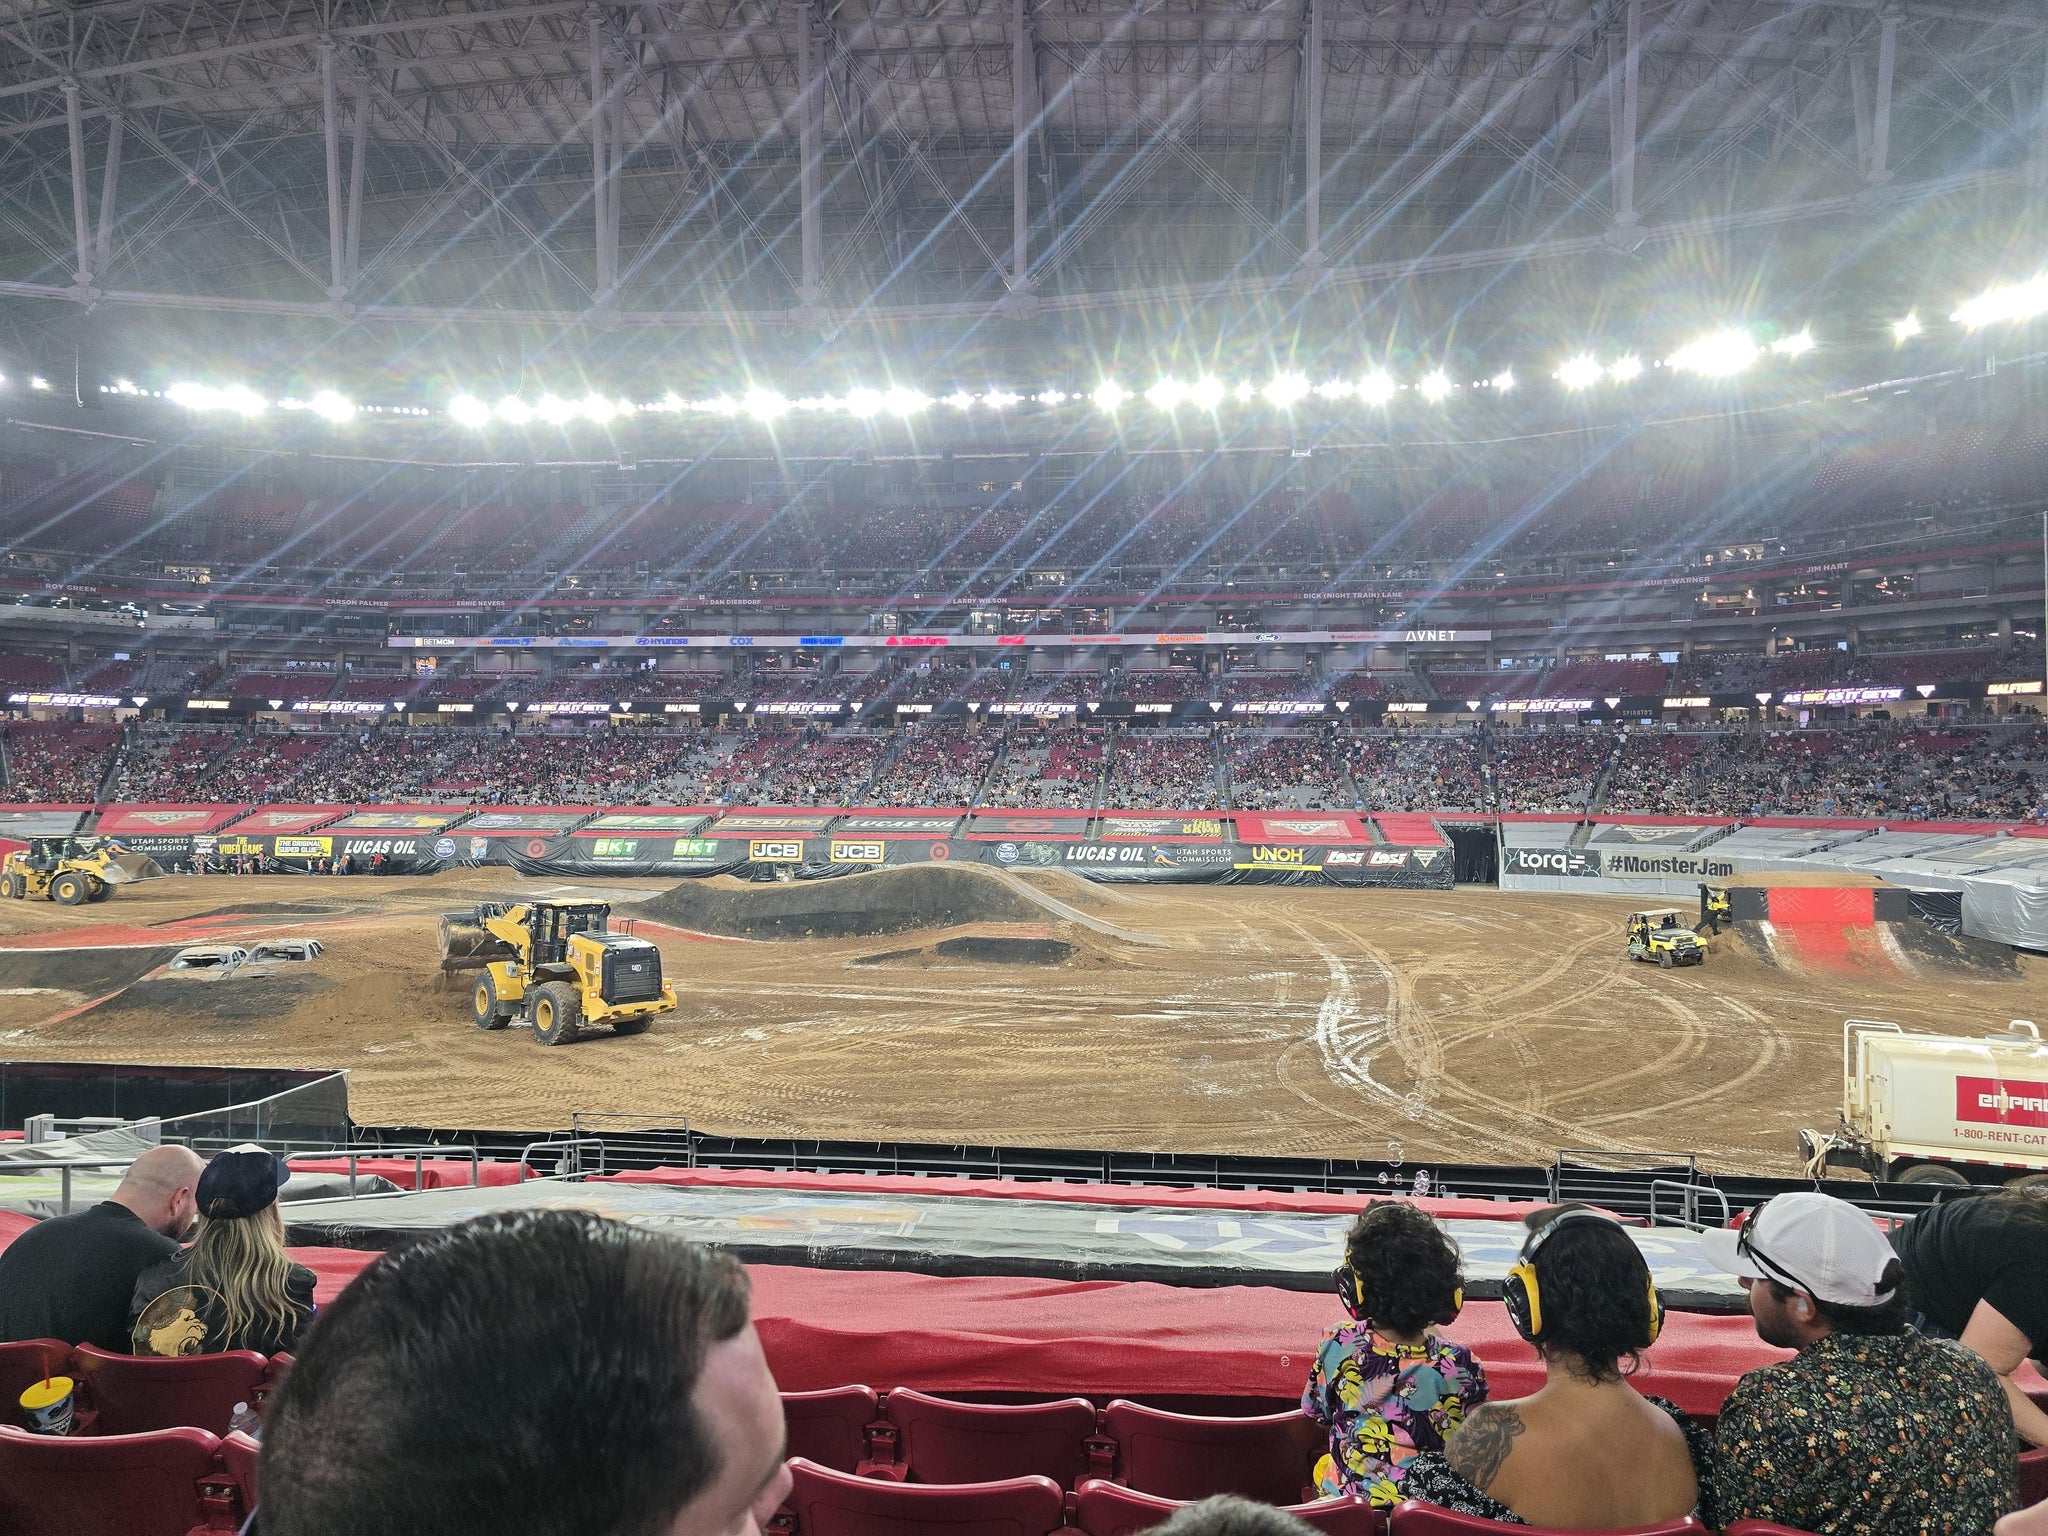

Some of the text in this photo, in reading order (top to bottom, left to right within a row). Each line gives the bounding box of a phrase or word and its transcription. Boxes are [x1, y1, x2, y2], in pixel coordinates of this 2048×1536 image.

[1806, 565, 1822, 573] JIM
[1823, 562, 1849, 571] HART
[1645, 576, 1711, 586] KURT WARNER
[45, 583, 63, 591] ROY
[66, 584, 97, 593] GREEN
[1323, 592, 1351, 600] (NIGHT
[325, 598, 390, 607] CARSON PALMER
[423, 637, 455, 645] BETMGM
[1405, 630, 1456, 641] AVNET
[729, 637, 754, 646] COX
[847, 819, 917, 828] LUCAS
[219, 844, 241, 854] VIDEO
[242, 844, 264, 854] GAME
[344, 840, 390, 854] LUCAS
[595, 842, 637, 854] BKT
[675, 842, 717, 854] BKT
[754, 844, 799, 857] JCB
[835, 845, 880, 858] JCB
[1066, 846, 1116, 861] LUCAS
[1252, 845, 1303, 862] UNOH
[1607, 855, 1734, 877] #MonsterJam
[1953, 1128, 2046, 1145] 1-800-RENT-CAT
